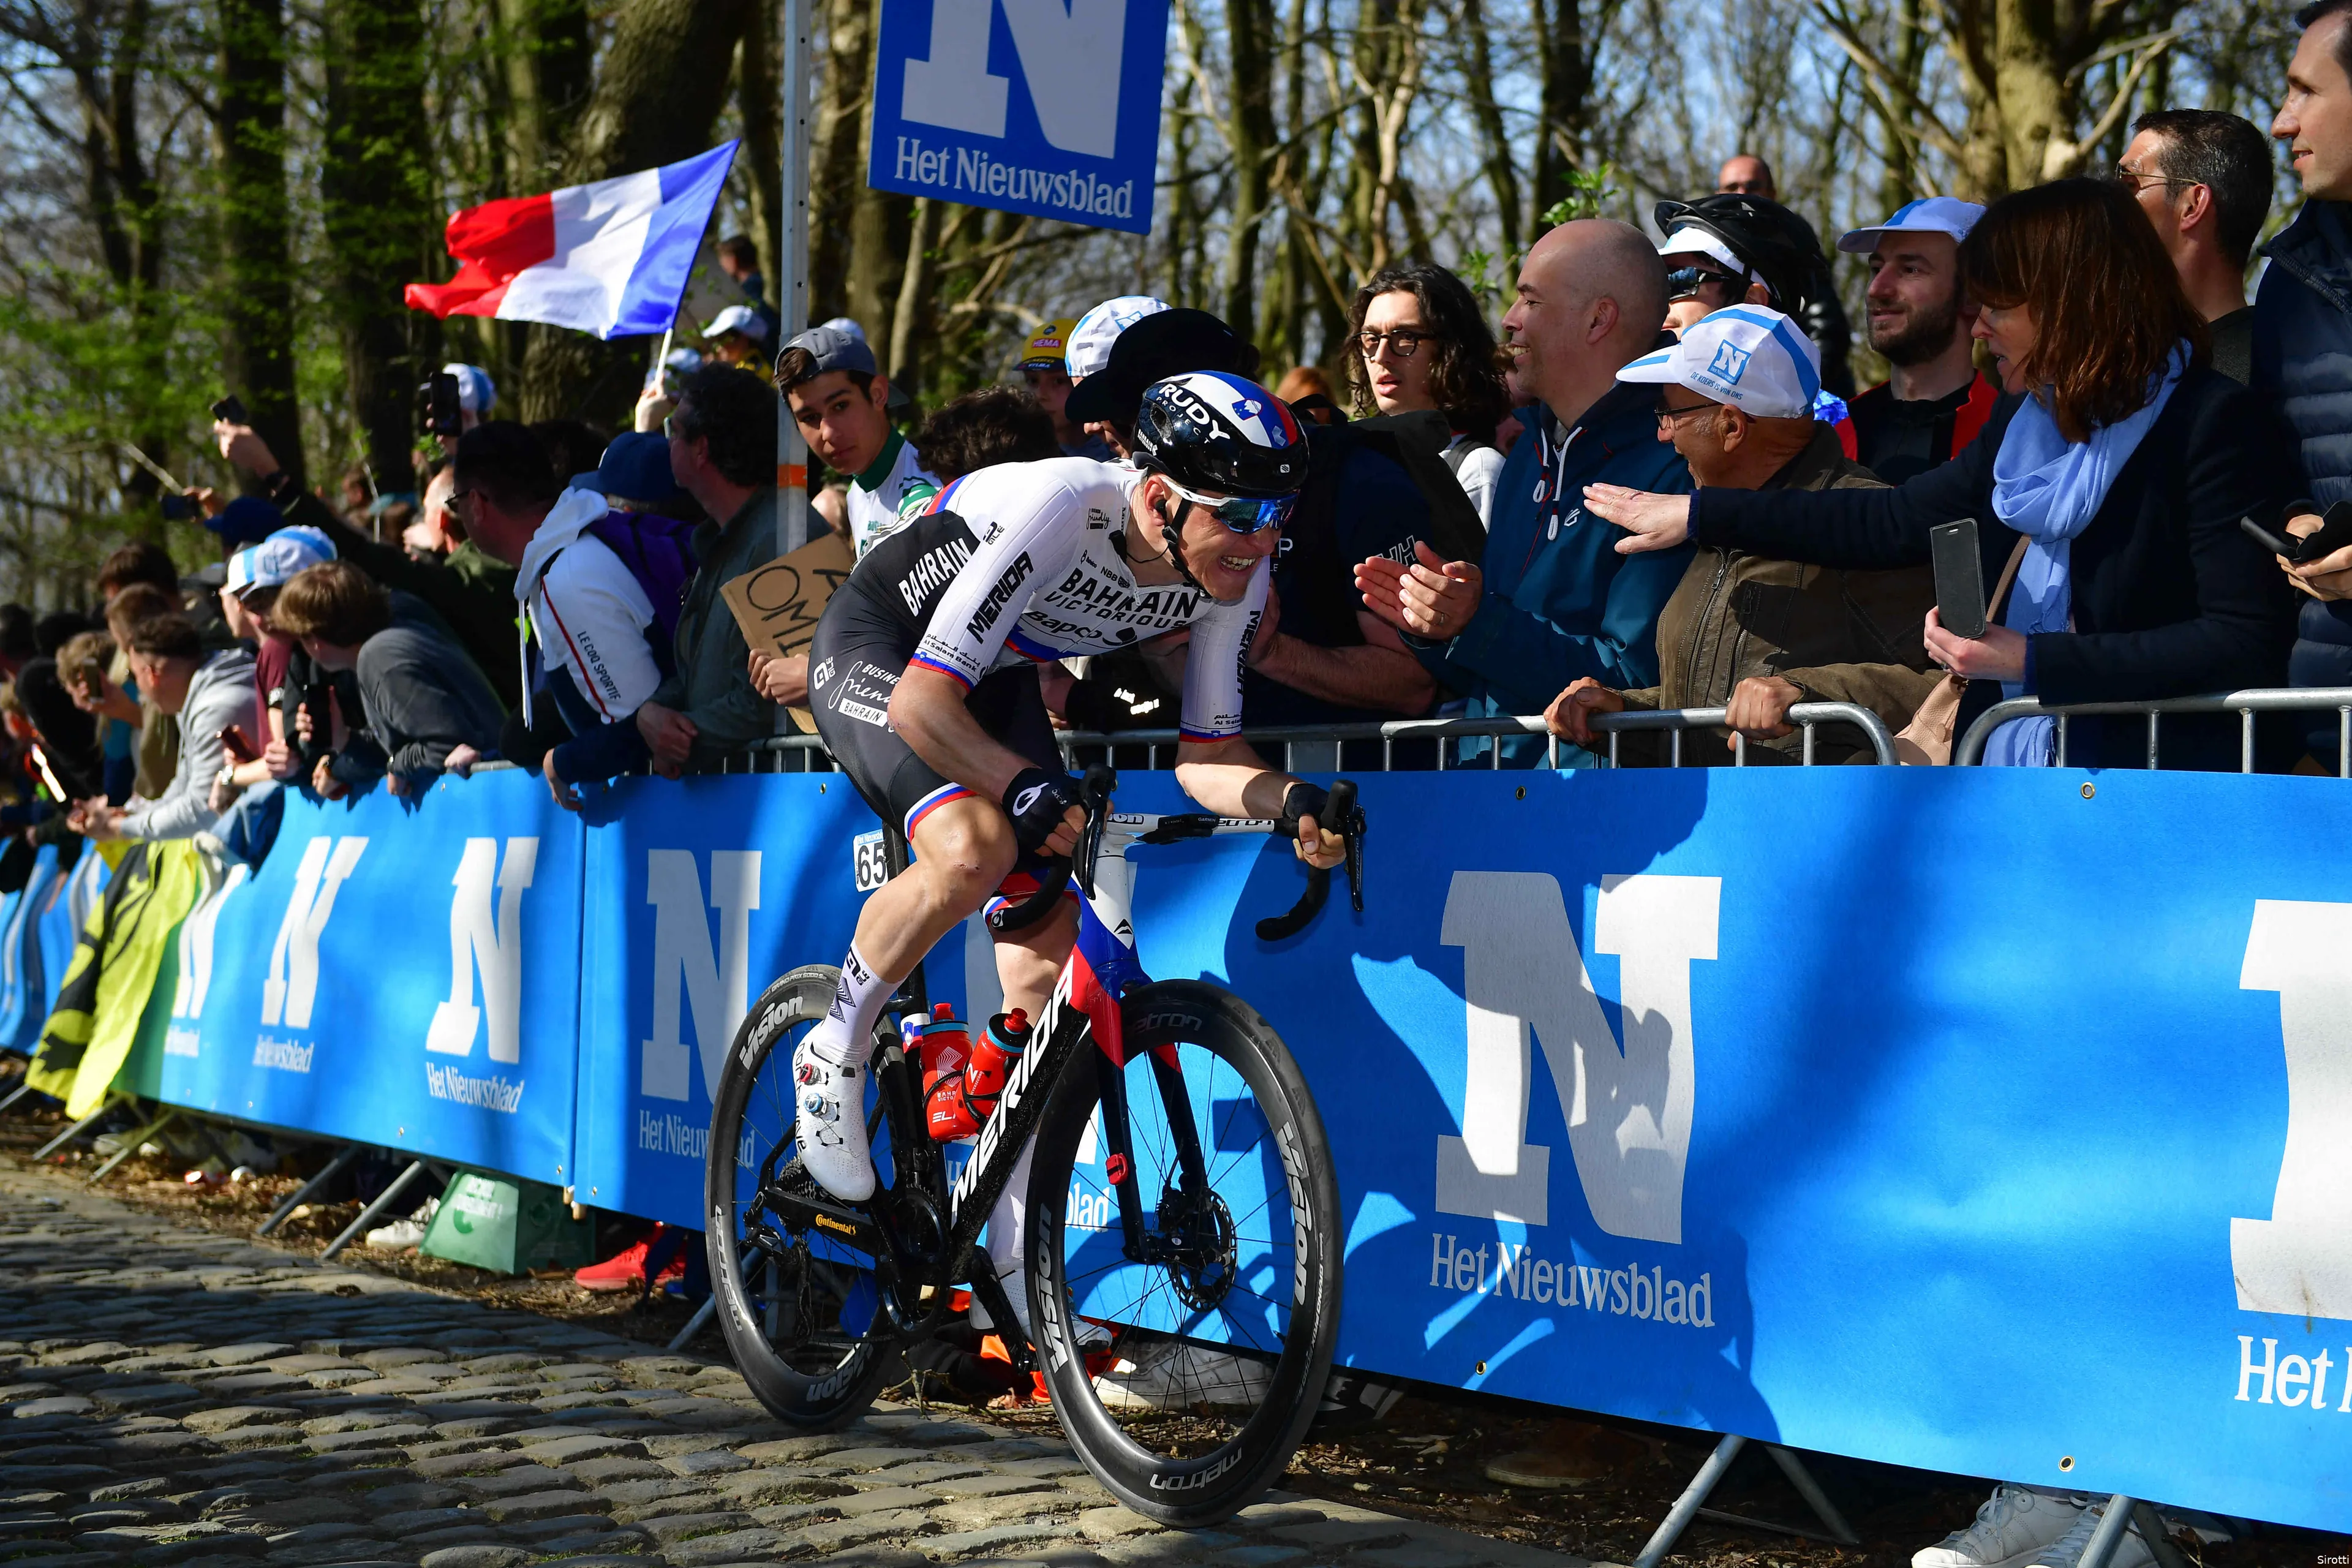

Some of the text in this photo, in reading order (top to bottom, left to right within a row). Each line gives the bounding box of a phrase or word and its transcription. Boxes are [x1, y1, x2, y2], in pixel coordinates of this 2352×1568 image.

[894, 136, 1133, 218] Het Nieuwsblad
[1697, 375, 1715, 387] KOERS
[1713, 343, 1747, 377] N
[1156, 396, 1210, 445] PROJECT
[1159, 383, 1231, 440] RUDY
[898, 538, 971, 617] BAHRAIN
[967, 551, 1034, 644] MERIDA
[1058, 567, 1200, 618] BAHRAIN
[1100, 566, 1118, 581] NBB
[1044, 590, 1187, 628] VICTORIOUS
[577, 631, 621, 701] LE COQ SPORTIF
[862, 663, 901, 685] BUSINE
[930, 643, 954, 658] Salam
[955, 656, 977, 672] Bank
[828, 660, 891, 709] frien
[844, 703, 883, 722] BAHRAIN
[858, 842, 886, 887] 65
[261, 836, 369, 1029] N
[426, 837, 540, 1064] N
[641, 849, 762, 1106] N
[1436, 870, 1722, 1245] N
[426, 1061, 525, 1114] Het Nieuwsblad
[951, 954, 1074, 1230] MERIDA
[639, 1109, 755, 1168] Het Nieuwad
[815, 1213, 851, 1235] Continental
[1430, 1232, 1715, 1328] Het Nieuwsblad
[2234, 1335, 2333, 1410] Het
[1149, 1447, 1242, 1491] metron
